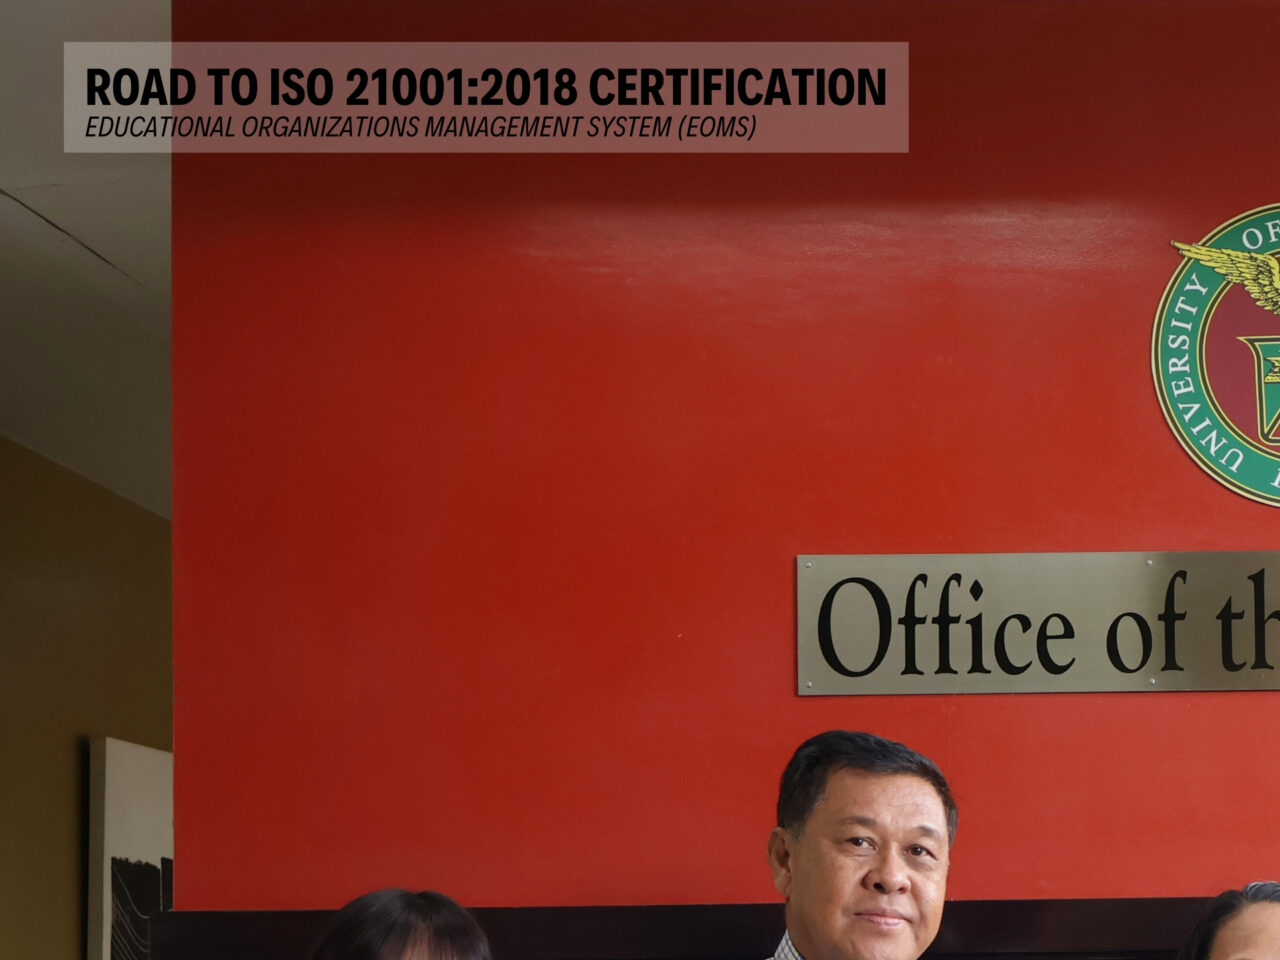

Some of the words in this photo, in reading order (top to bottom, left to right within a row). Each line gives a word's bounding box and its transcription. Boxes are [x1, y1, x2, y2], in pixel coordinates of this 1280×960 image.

[1167, 272, 1245, 473] UNIVERSITY
[817, 572, 1076, 678] Office
[1106, 569, 1188, 674] of
